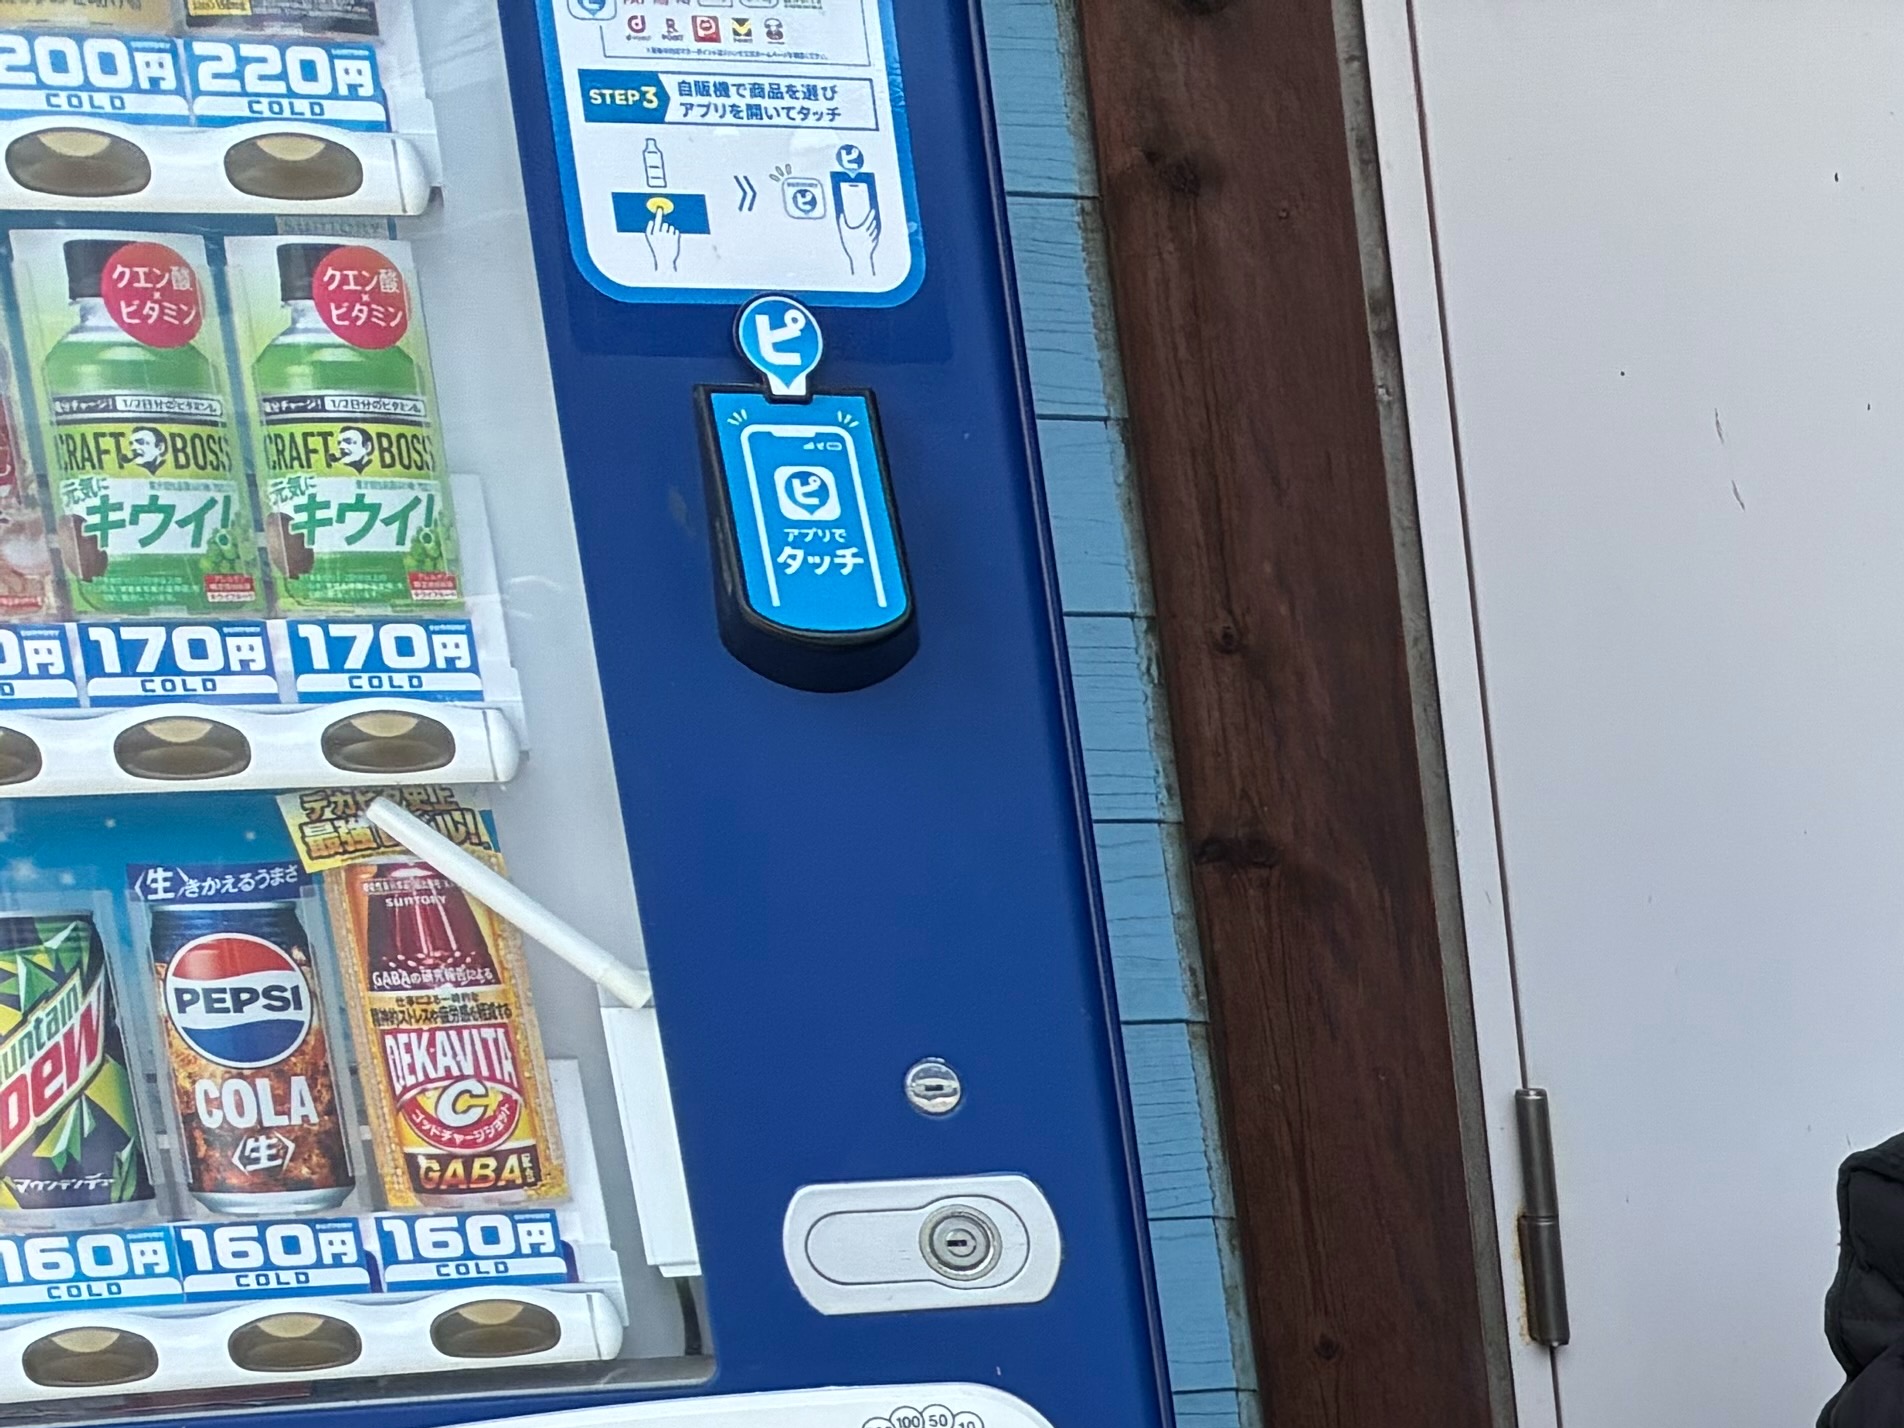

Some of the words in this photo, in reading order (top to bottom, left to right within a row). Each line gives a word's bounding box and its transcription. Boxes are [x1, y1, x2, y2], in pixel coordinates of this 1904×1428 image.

[0, 35, 177, 90] 200円
[193, 42, 374, 97] 220円
[46, 93, 126, 110] COLD
[677, 80, 837, 101] 自販機で商品を選び
[248, 100, 325, 117] COLD
[680, 102, 841, 123] アプリを開いてタッチ
[112, 264, 192, 290] クエン酸
[323, 267, 400, 293] クエン酸
[120, 300, 196, 324] ビタミン
[330, 302, 403, 327] ビタミン
[755, 308, 806, 365] ピ
[376, 431, 435, 471] BOSS
[269, 475, 317, 505] 元気に
[791, 476, 820, 504] ピ
[291, 493, 434, 546] キウイ!
[783, 528, 846, 542] アプリで
[777, 546, 864, 575] タッチ
[89, 625, 268, 674] 170円
[297, 624, 471, 671] 170円
[141, 677, 217, 694] COLD
[348, 674, 423, 690] COLD
[174, 984, 303, 1014] PEPSI
[385, 1028, 518, 1089] DEKAVITA
[194, 1076, 318, 1129] COLA
[418, 1154, 522, 1189] GABA
[181, 1223, 358, 1271] 160円
[382, 1214, 556, 1260] 160円
[2, 1234, 165, 1283] 160円
[436, 1261, 509, 1277] COLD
[47, 1281, 122, 1298] COLD
[235, 1271, 310, 1288] COLD
[896, 1415, 920, 1428] 100
[928, 1414, 948, 1427] 50
